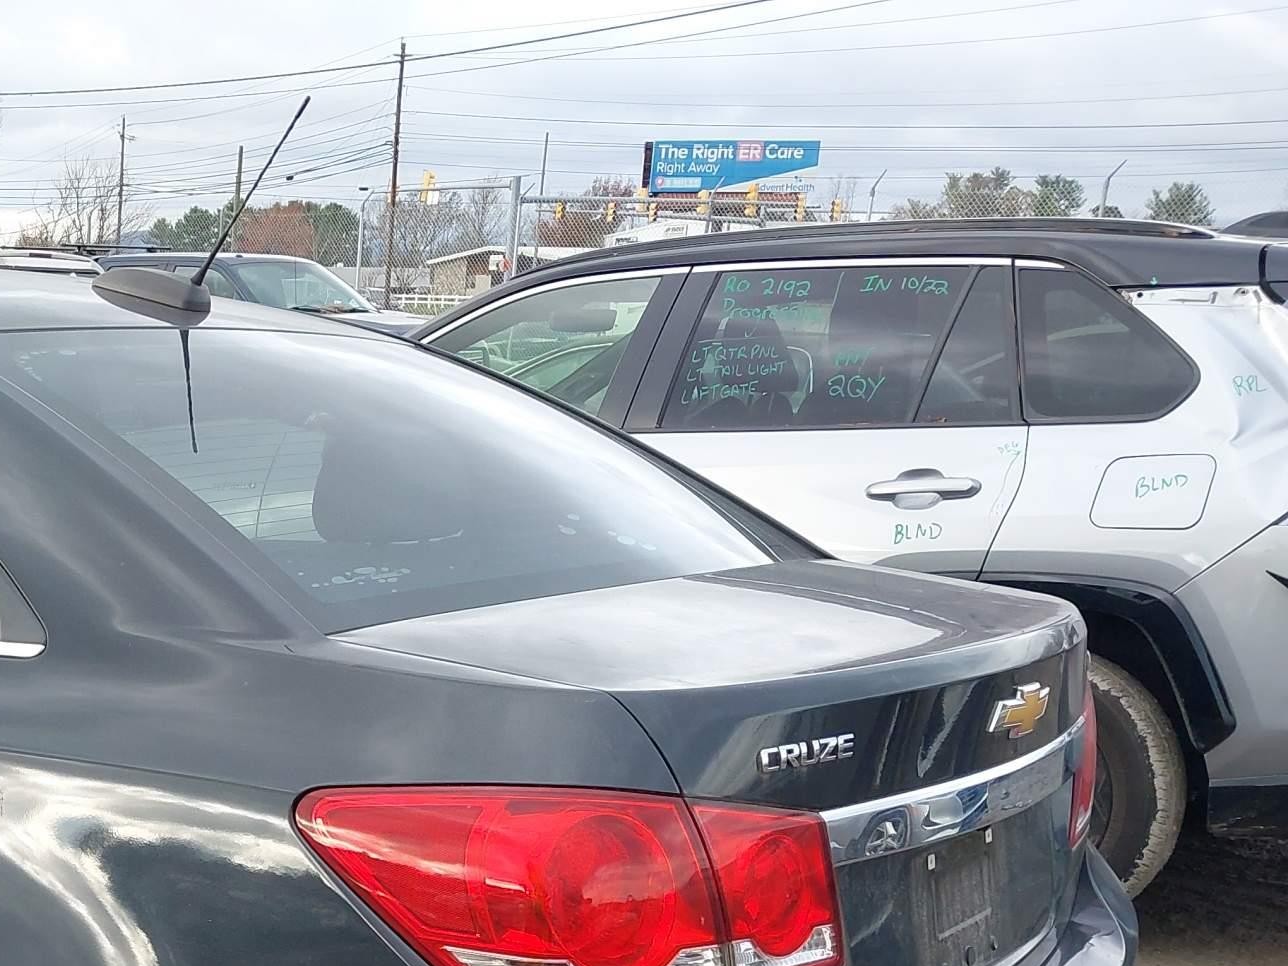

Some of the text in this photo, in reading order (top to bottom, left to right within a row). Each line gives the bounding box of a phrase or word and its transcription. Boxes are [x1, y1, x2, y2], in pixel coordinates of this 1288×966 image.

[658, 143, 804, 162] The Right ER Care
[656, 161, 721, 175] Right Away
[724, 276, 811, 298] RO 2192
[859, 275, 892, 293] IN
[692, 346, 712, 363] LT
[686, 360, 787, 382] LT TAIL LIGHT
[828, 374, 886, 402] 2QY
[1232, 374, 1268, 397] RPL
[1135, 474, 1189, 499] BLND
[893, 522, 943, 545] BLND
[758, 732, 855, 774] CRUZE
